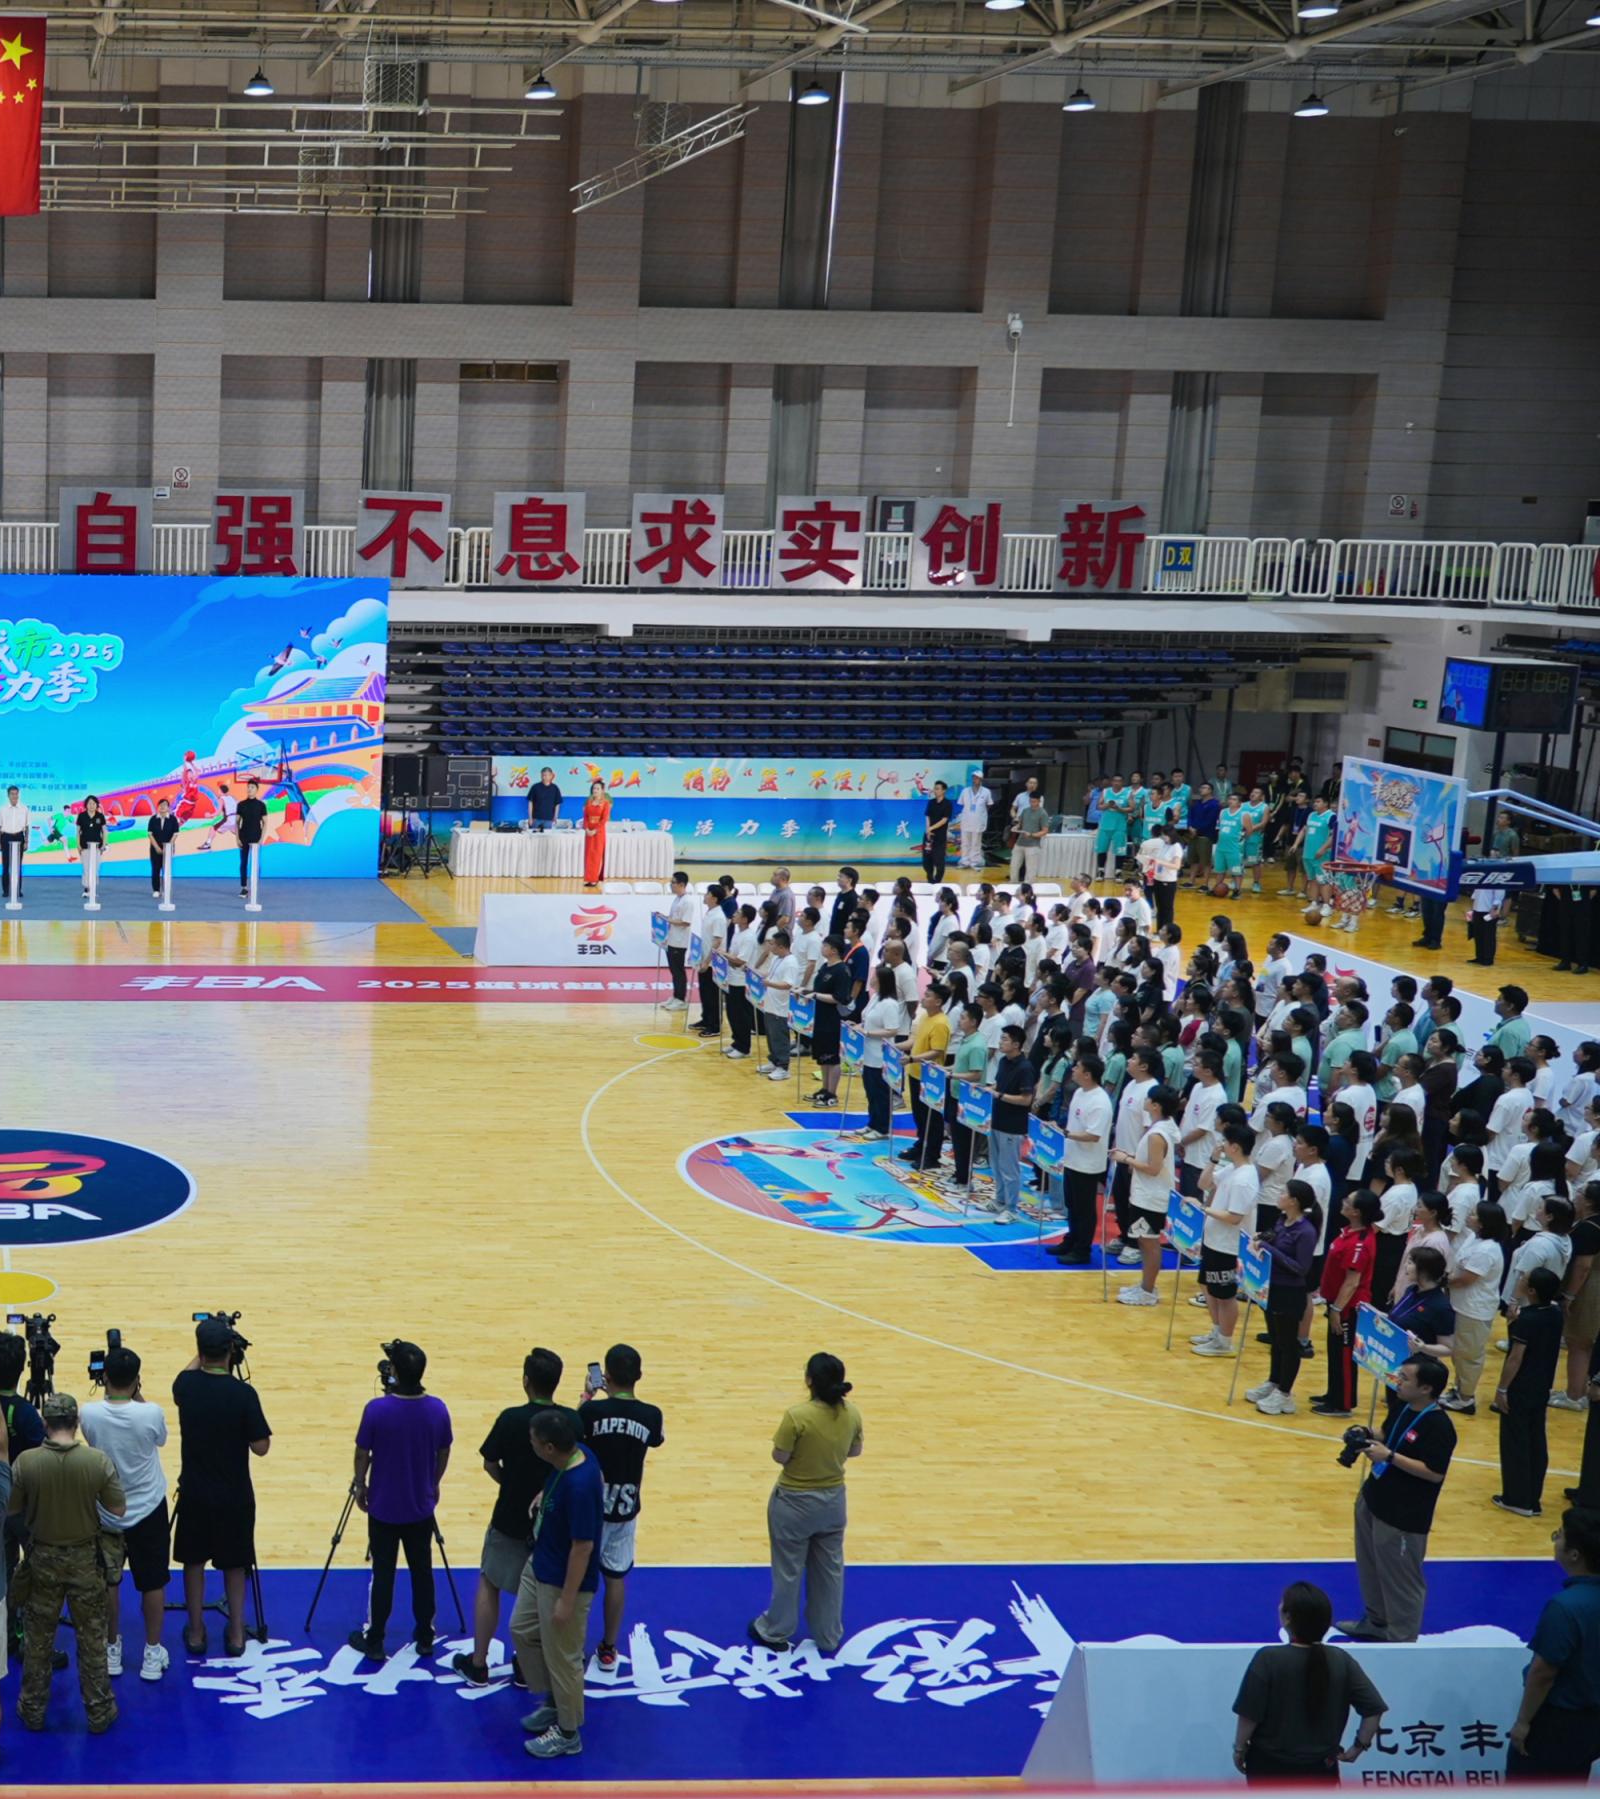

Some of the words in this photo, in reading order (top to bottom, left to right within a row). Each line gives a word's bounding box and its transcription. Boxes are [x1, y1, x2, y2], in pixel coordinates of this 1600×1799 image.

[75, 492, 1145, 589] 自强不息求实创新
[49, 642, 116, 661] 2025
[592, 1417, 626, 1437] AAPE
[626, 1420, 651, 1444] NOW
[1362, 1770, 1454, 1787] FENGTAI
